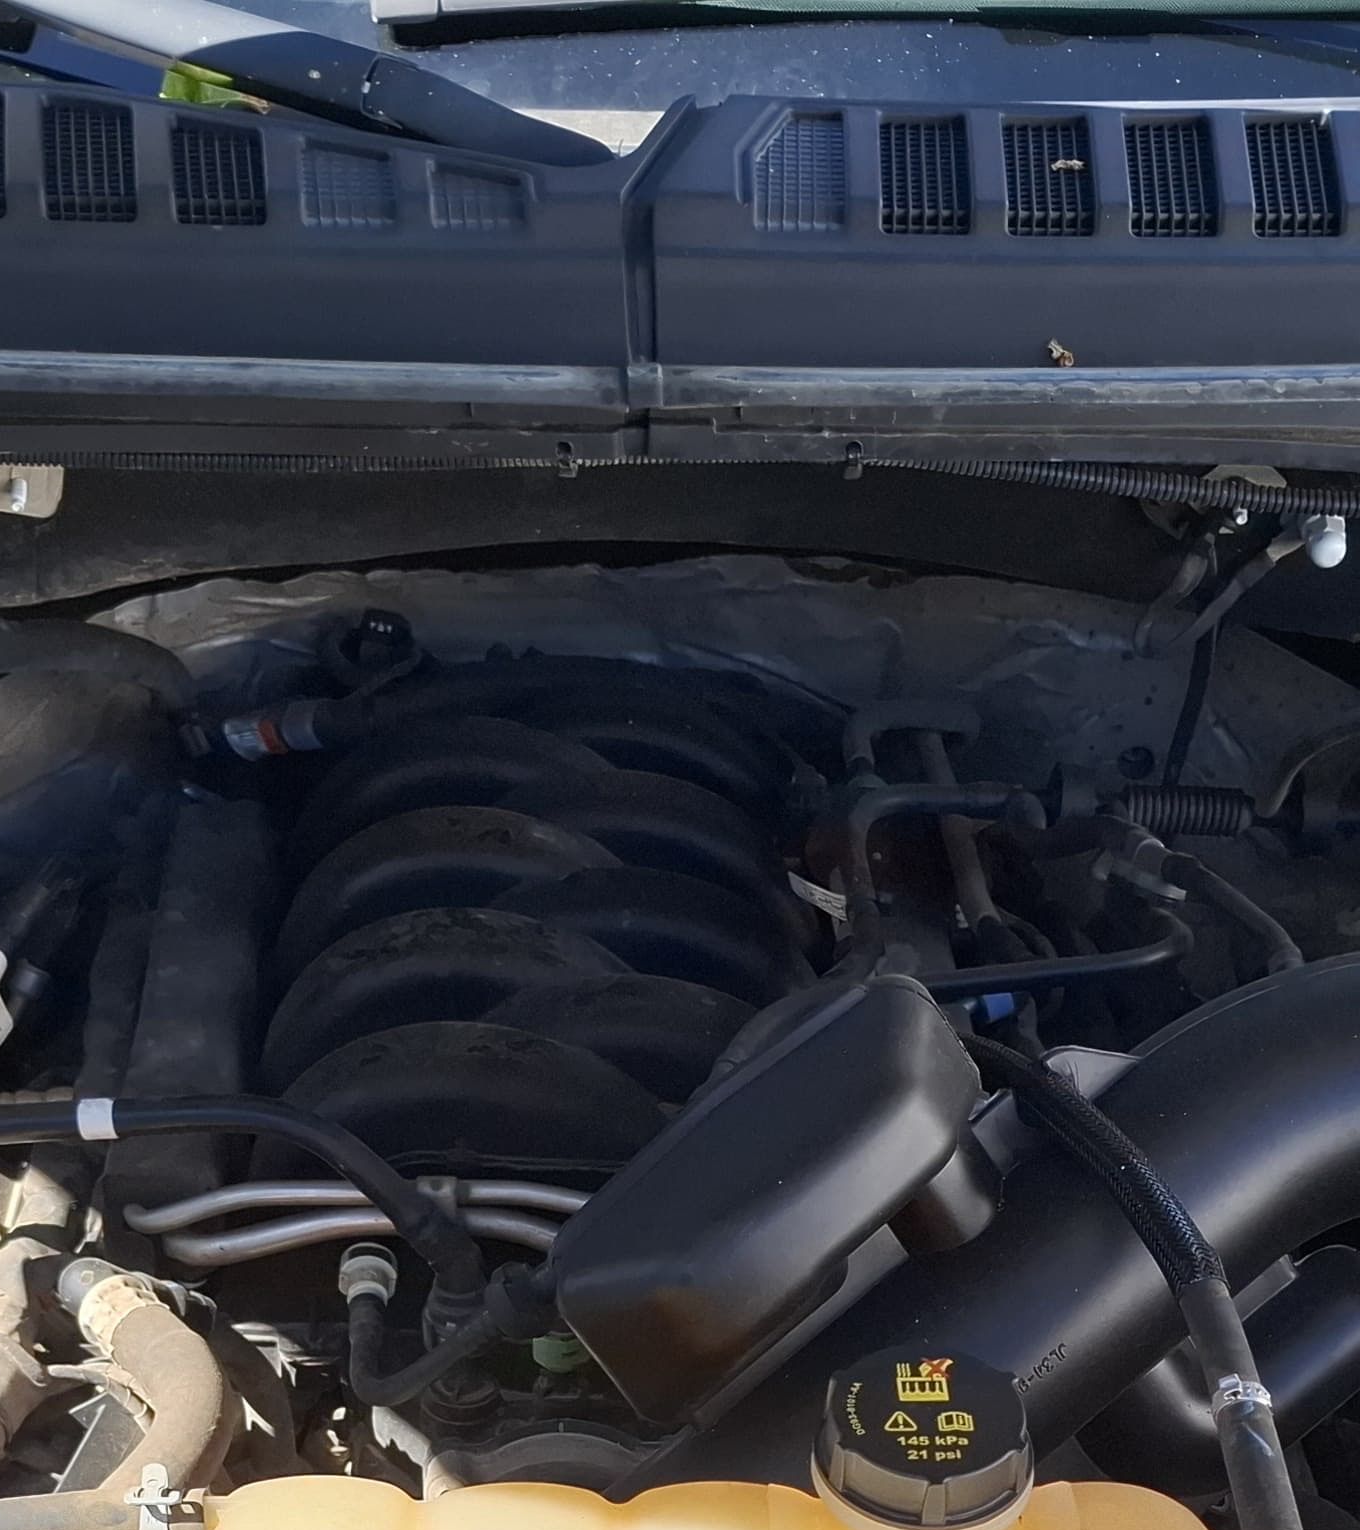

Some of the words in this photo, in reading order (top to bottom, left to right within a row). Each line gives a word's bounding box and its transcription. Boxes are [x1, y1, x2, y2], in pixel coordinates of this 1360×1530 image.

[897, 1436, 930, 1446] 145
[935, 1435, 969, 1446] kPa
[907, 1449, 928, 1460] 21
[935, 1449, 962, 1462] psi
